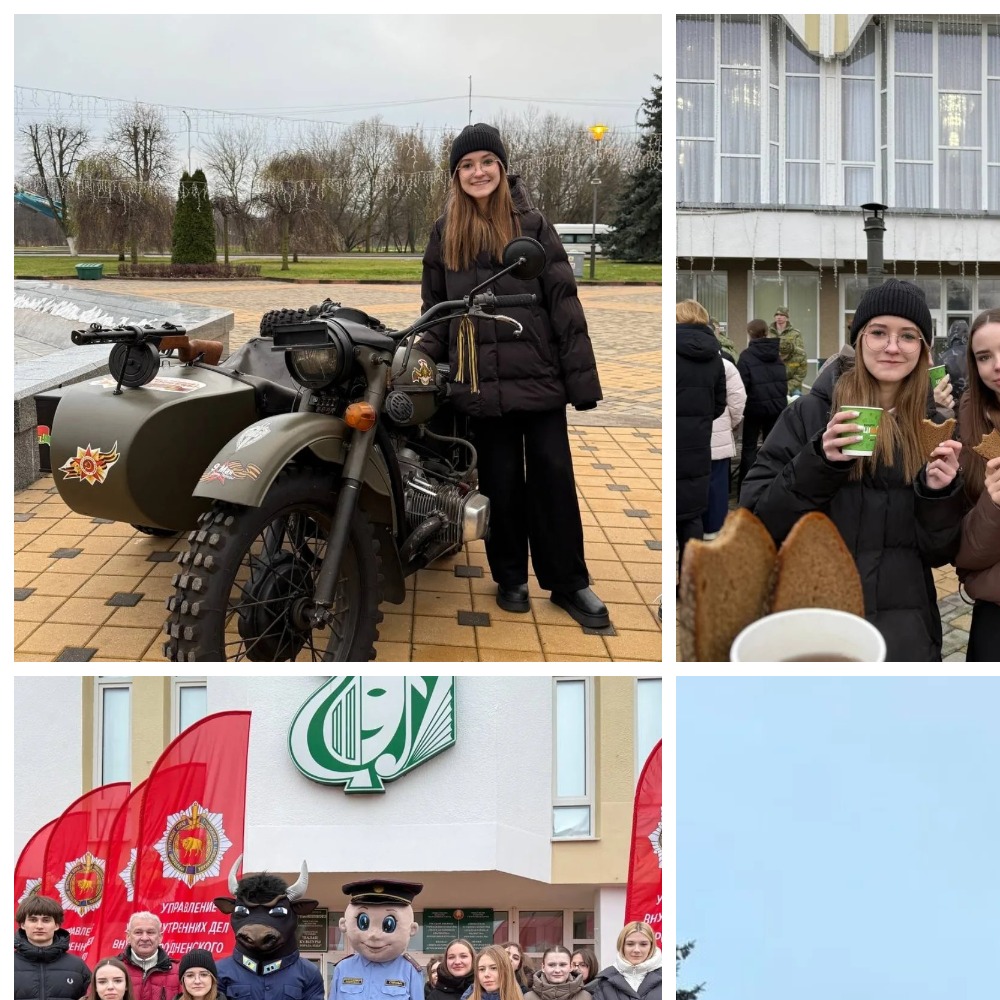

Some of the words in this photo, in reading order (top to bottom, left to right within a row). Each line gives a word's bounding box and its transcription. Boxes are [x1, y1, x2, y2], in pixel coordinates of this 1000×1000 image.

[160, 902, 218, 914] УПРАВЛЕНИЕ
[160, 922, 208, 933] УТРЕННИХ
[208, 921, 229, 935] ДЕЛ
[160, 942, 224, 955] ОДНЕНСКОГО
